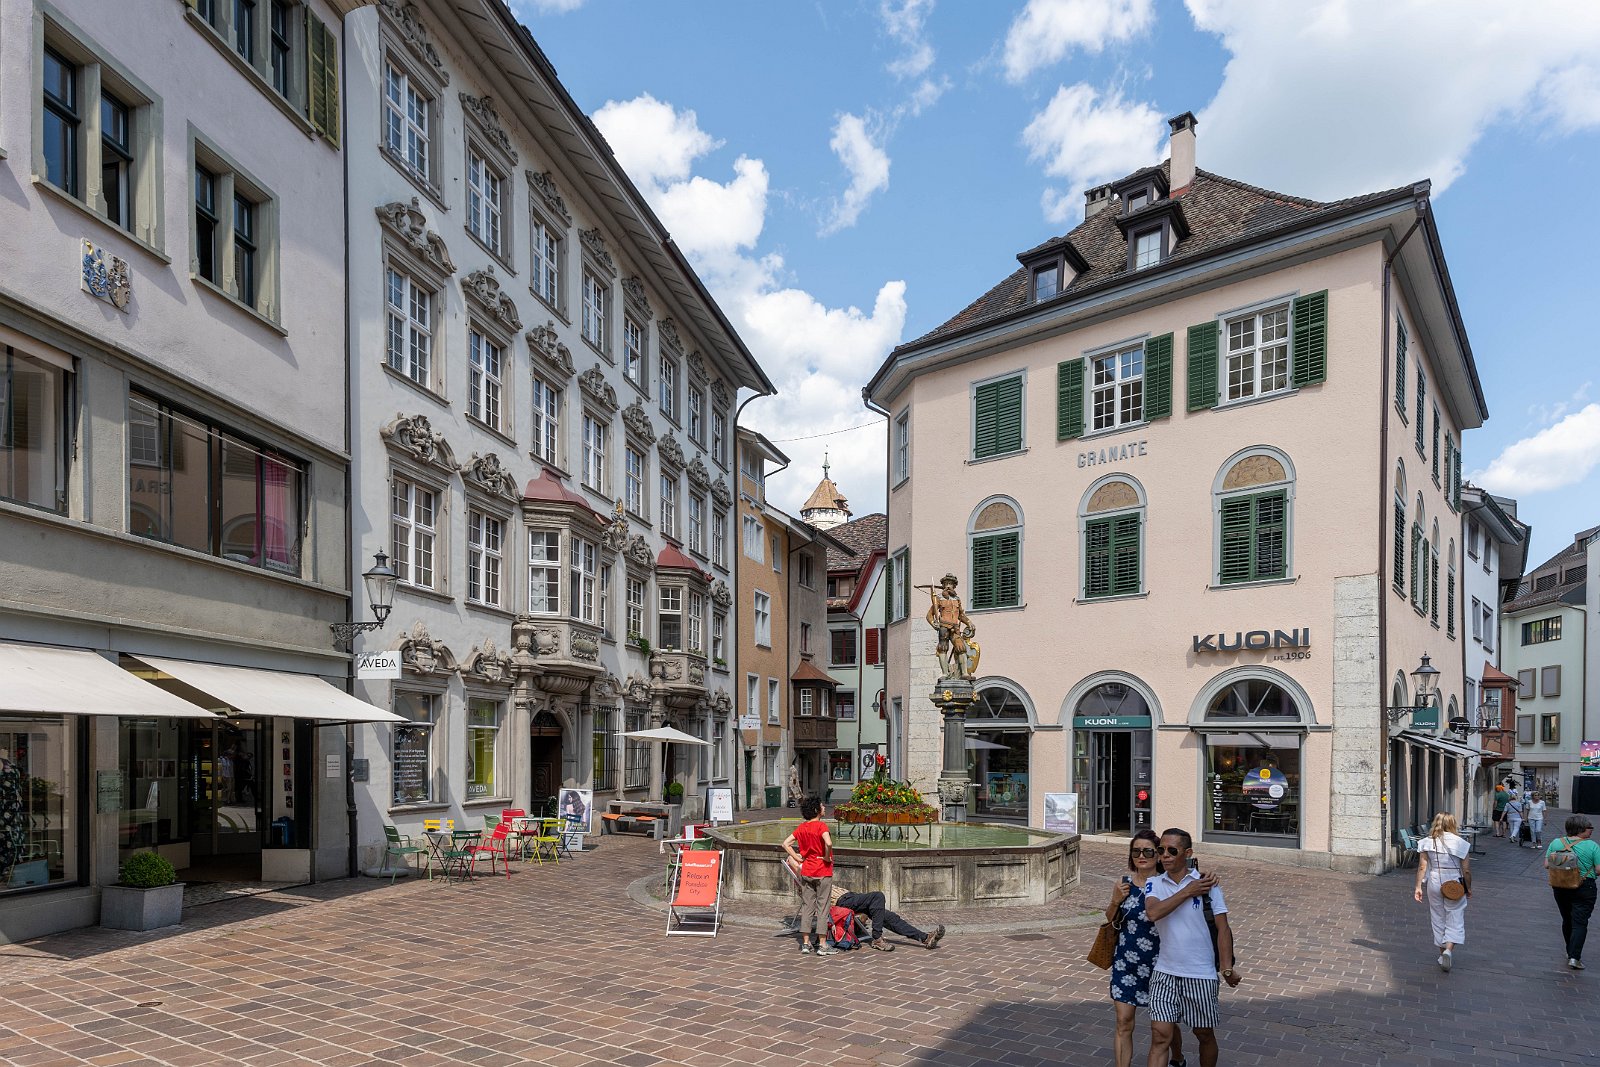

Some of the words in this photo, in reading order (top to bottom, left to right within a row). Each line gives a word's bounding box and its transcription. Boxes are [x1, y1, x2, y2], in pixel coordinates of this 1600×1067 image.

[1077, 440, 1148, 468] GRANATE
[1193, 627, 1310, 653] KUONI
[1286, 651, 1311, 660] 1906
[361, 658, 396, 668] AVEDA
[1084, 718, 1117, 726] KUONI
[468, 784, 488, 793] AVEDA
[686, 871, 703, 880] Relax
[689, 888, 701, 896] City
[1145, 881, 1153, 894] 3
